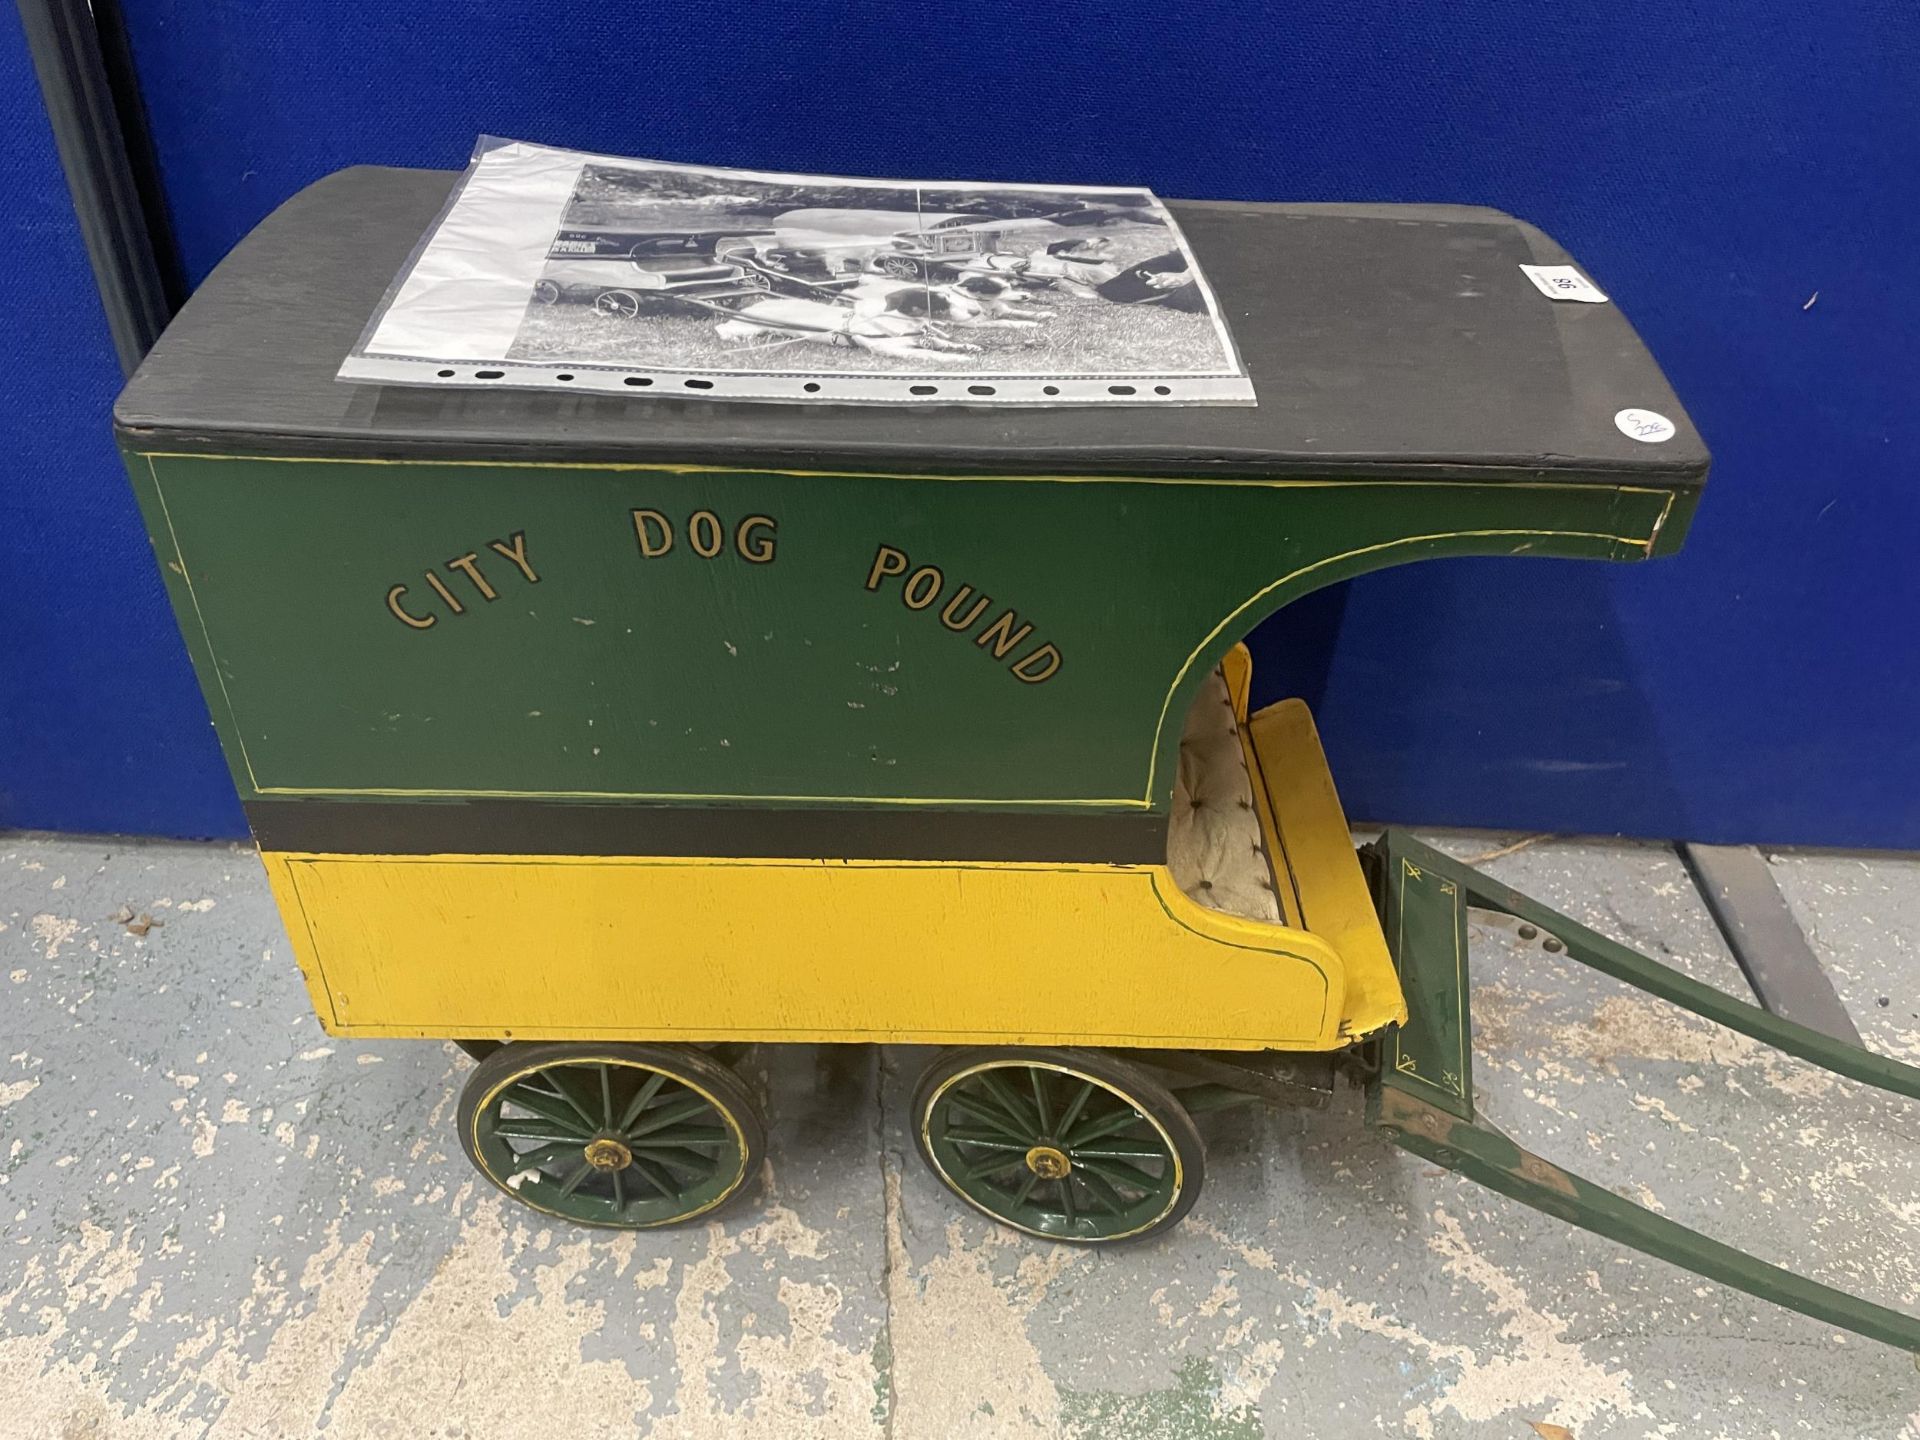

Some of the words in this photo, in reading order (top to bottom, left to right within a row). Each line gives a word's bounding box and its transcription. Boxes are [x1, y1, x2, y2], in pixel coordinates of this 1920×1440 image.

[386, 532, 540, 629] CITY
[631, 509, 777, 563] DOG
[865, 544, 1063, 683] POUND
